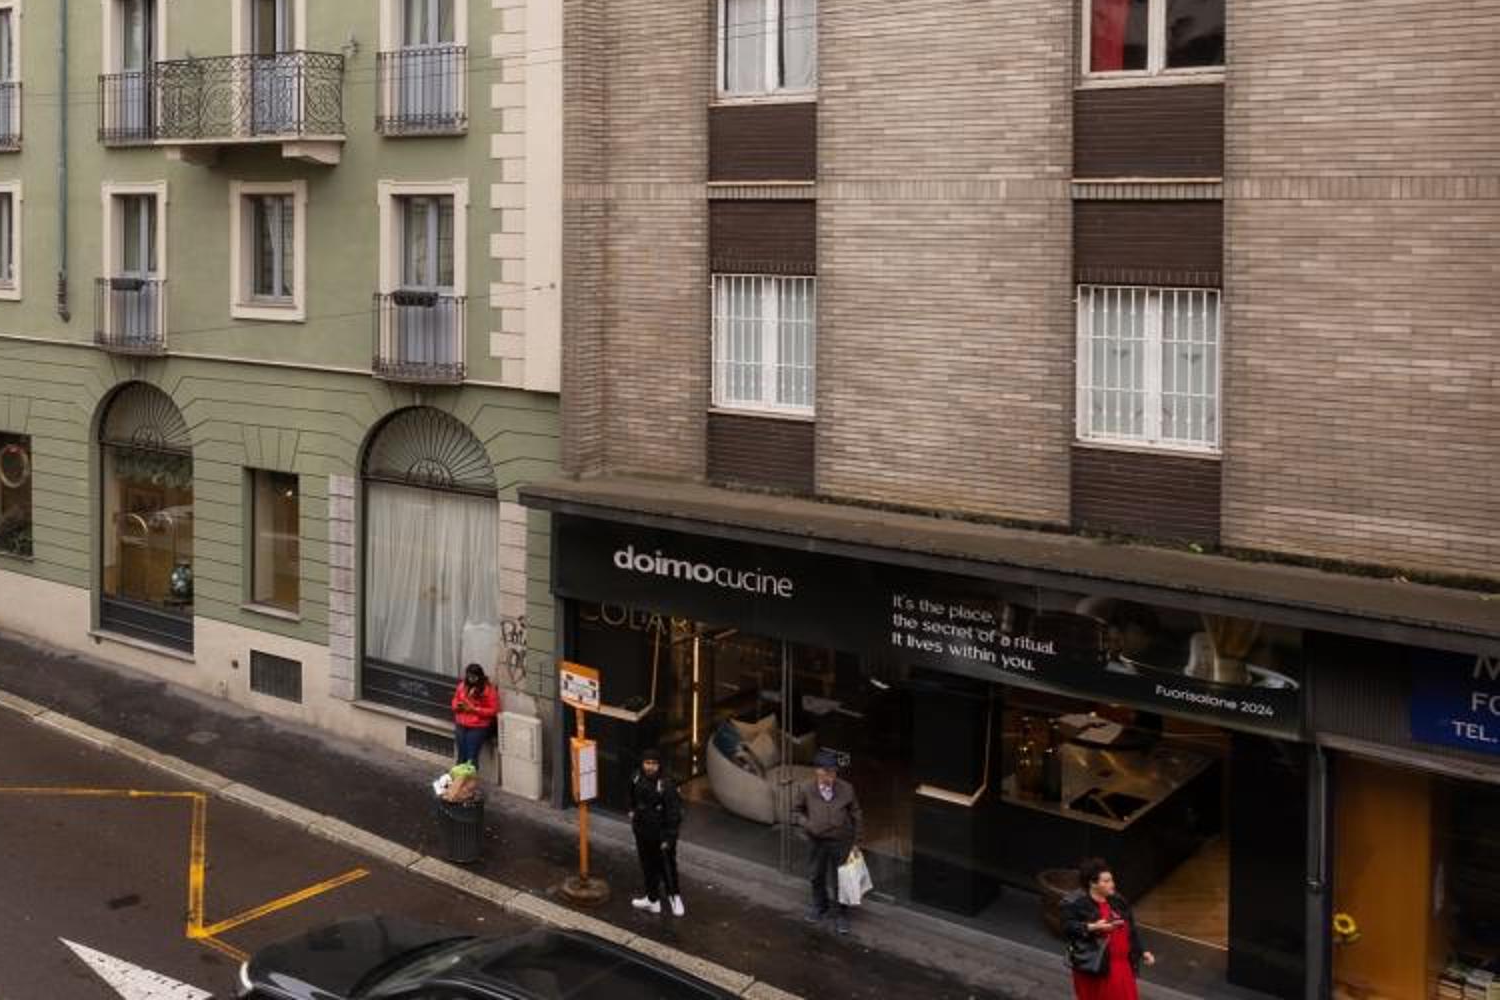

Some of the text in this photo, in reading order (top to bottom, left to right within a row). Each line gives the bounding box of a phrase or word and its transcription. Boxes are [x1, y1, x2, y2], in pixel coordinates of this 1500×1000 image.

[613, 545, 793, 598] doimocucine
[919, 600, 945, 615] the
[950, 605, 996, 625] place,
[893, 613, 1058, 655] the secret of a ritual.
[907, 634, 943, 653] lives
[948, 643, 997, 663] within
[1001, 654, 1036, 671] you.
[1240, 701, 1274, 717] 2024
[1451, 720, 1498, 743] TEL.
